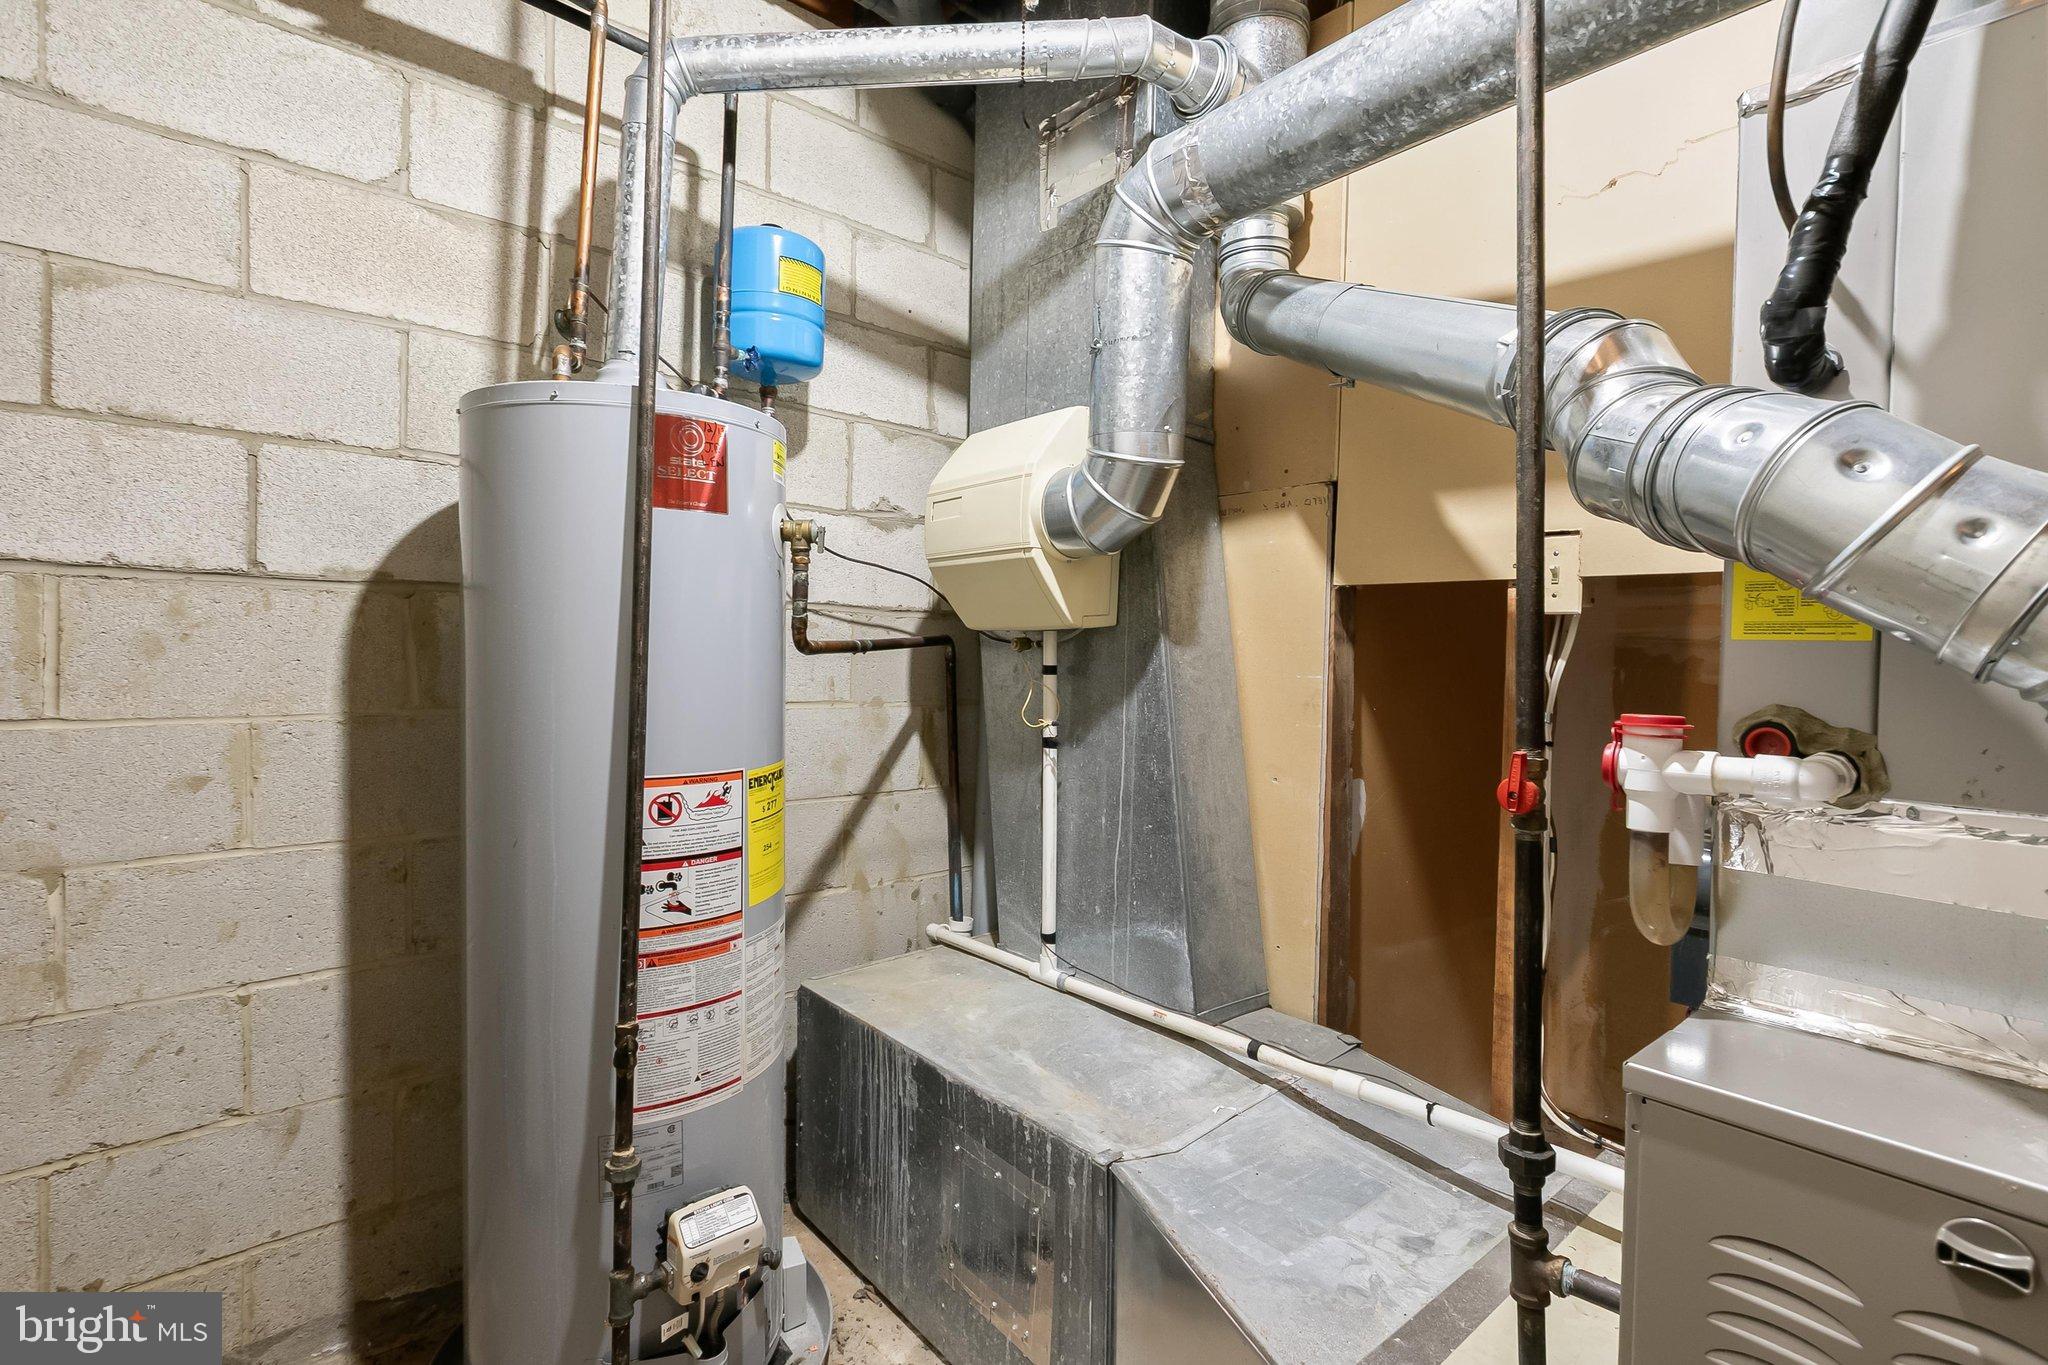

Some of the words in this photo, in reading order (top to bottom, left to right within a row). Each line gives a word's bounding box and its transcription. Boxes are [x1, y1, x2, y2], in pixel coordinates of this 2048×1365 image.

[657, 465, 717, 481] SELECT
[689, 776, 718, 785] WARNING
[762, 841, 772, 853] 254
[690, 856, 719, 866] DANGER
